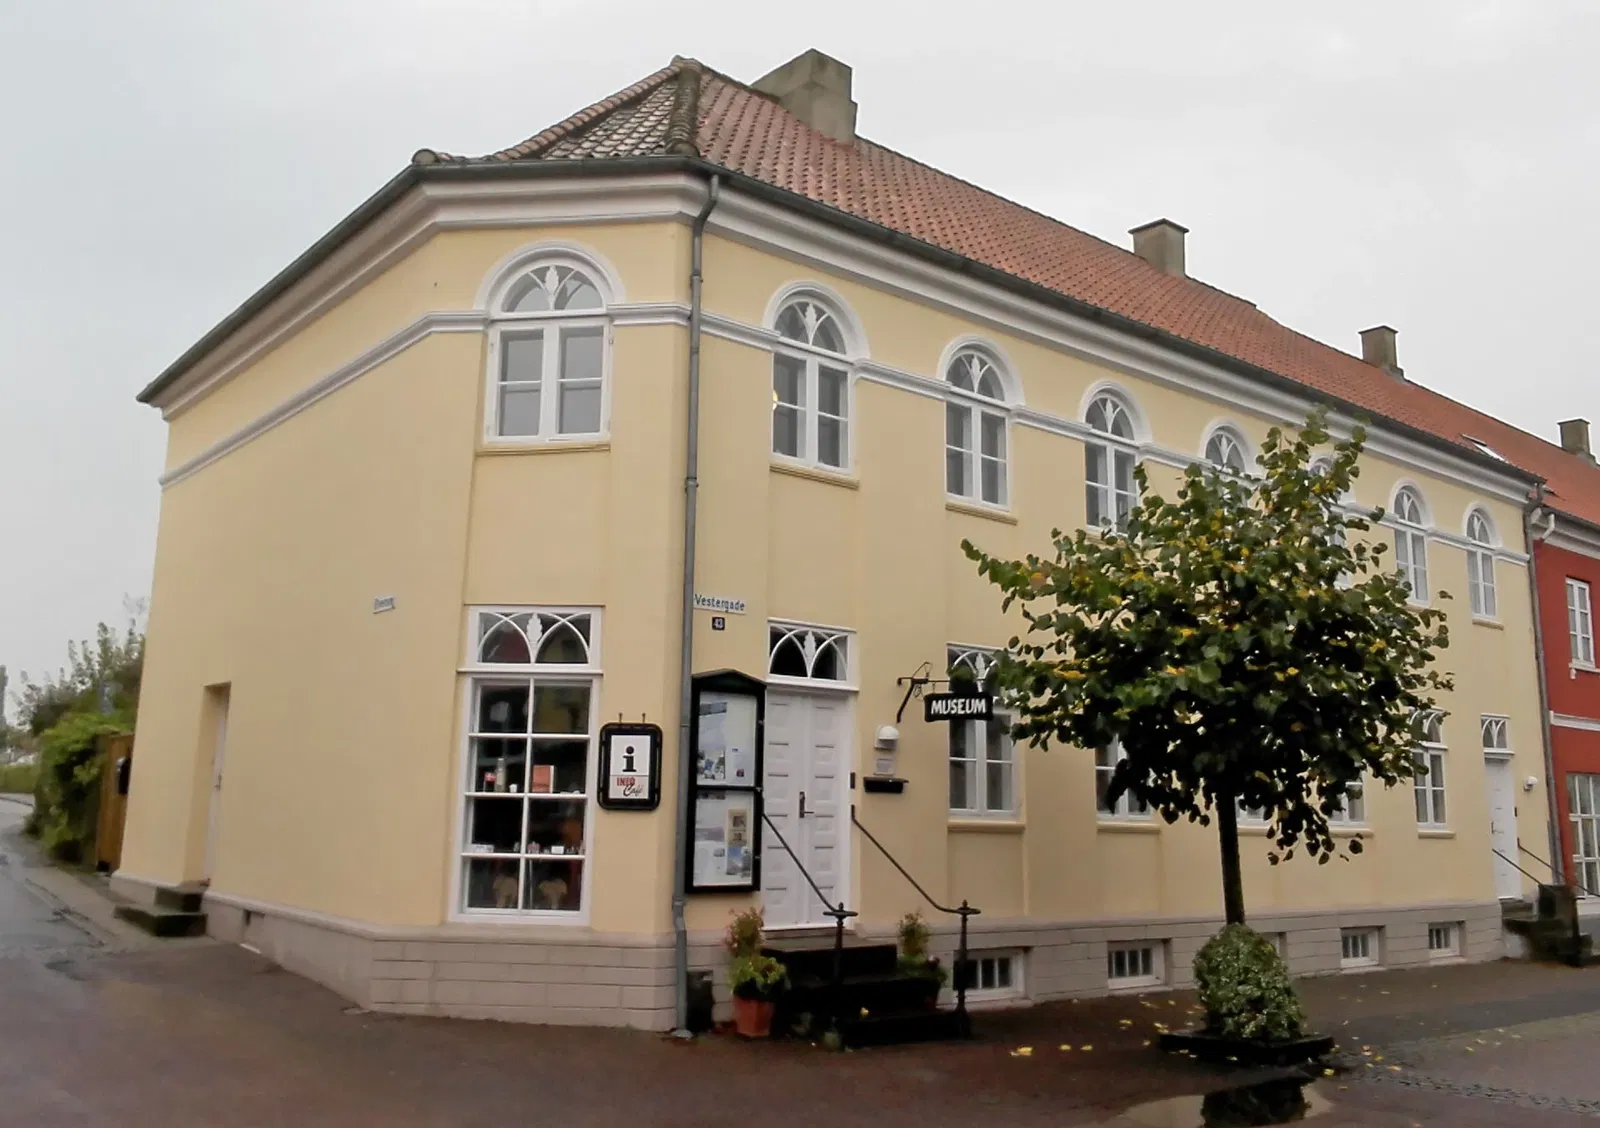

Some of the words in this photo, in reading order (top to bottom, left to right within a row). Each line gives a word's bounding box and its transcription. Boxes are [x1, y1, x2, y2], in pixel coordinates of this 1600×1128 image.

[694, 593, 745, 613] Vestergade
[931, 698, 986, 715] MUSEUM
[622, 746, 637, 772] i
